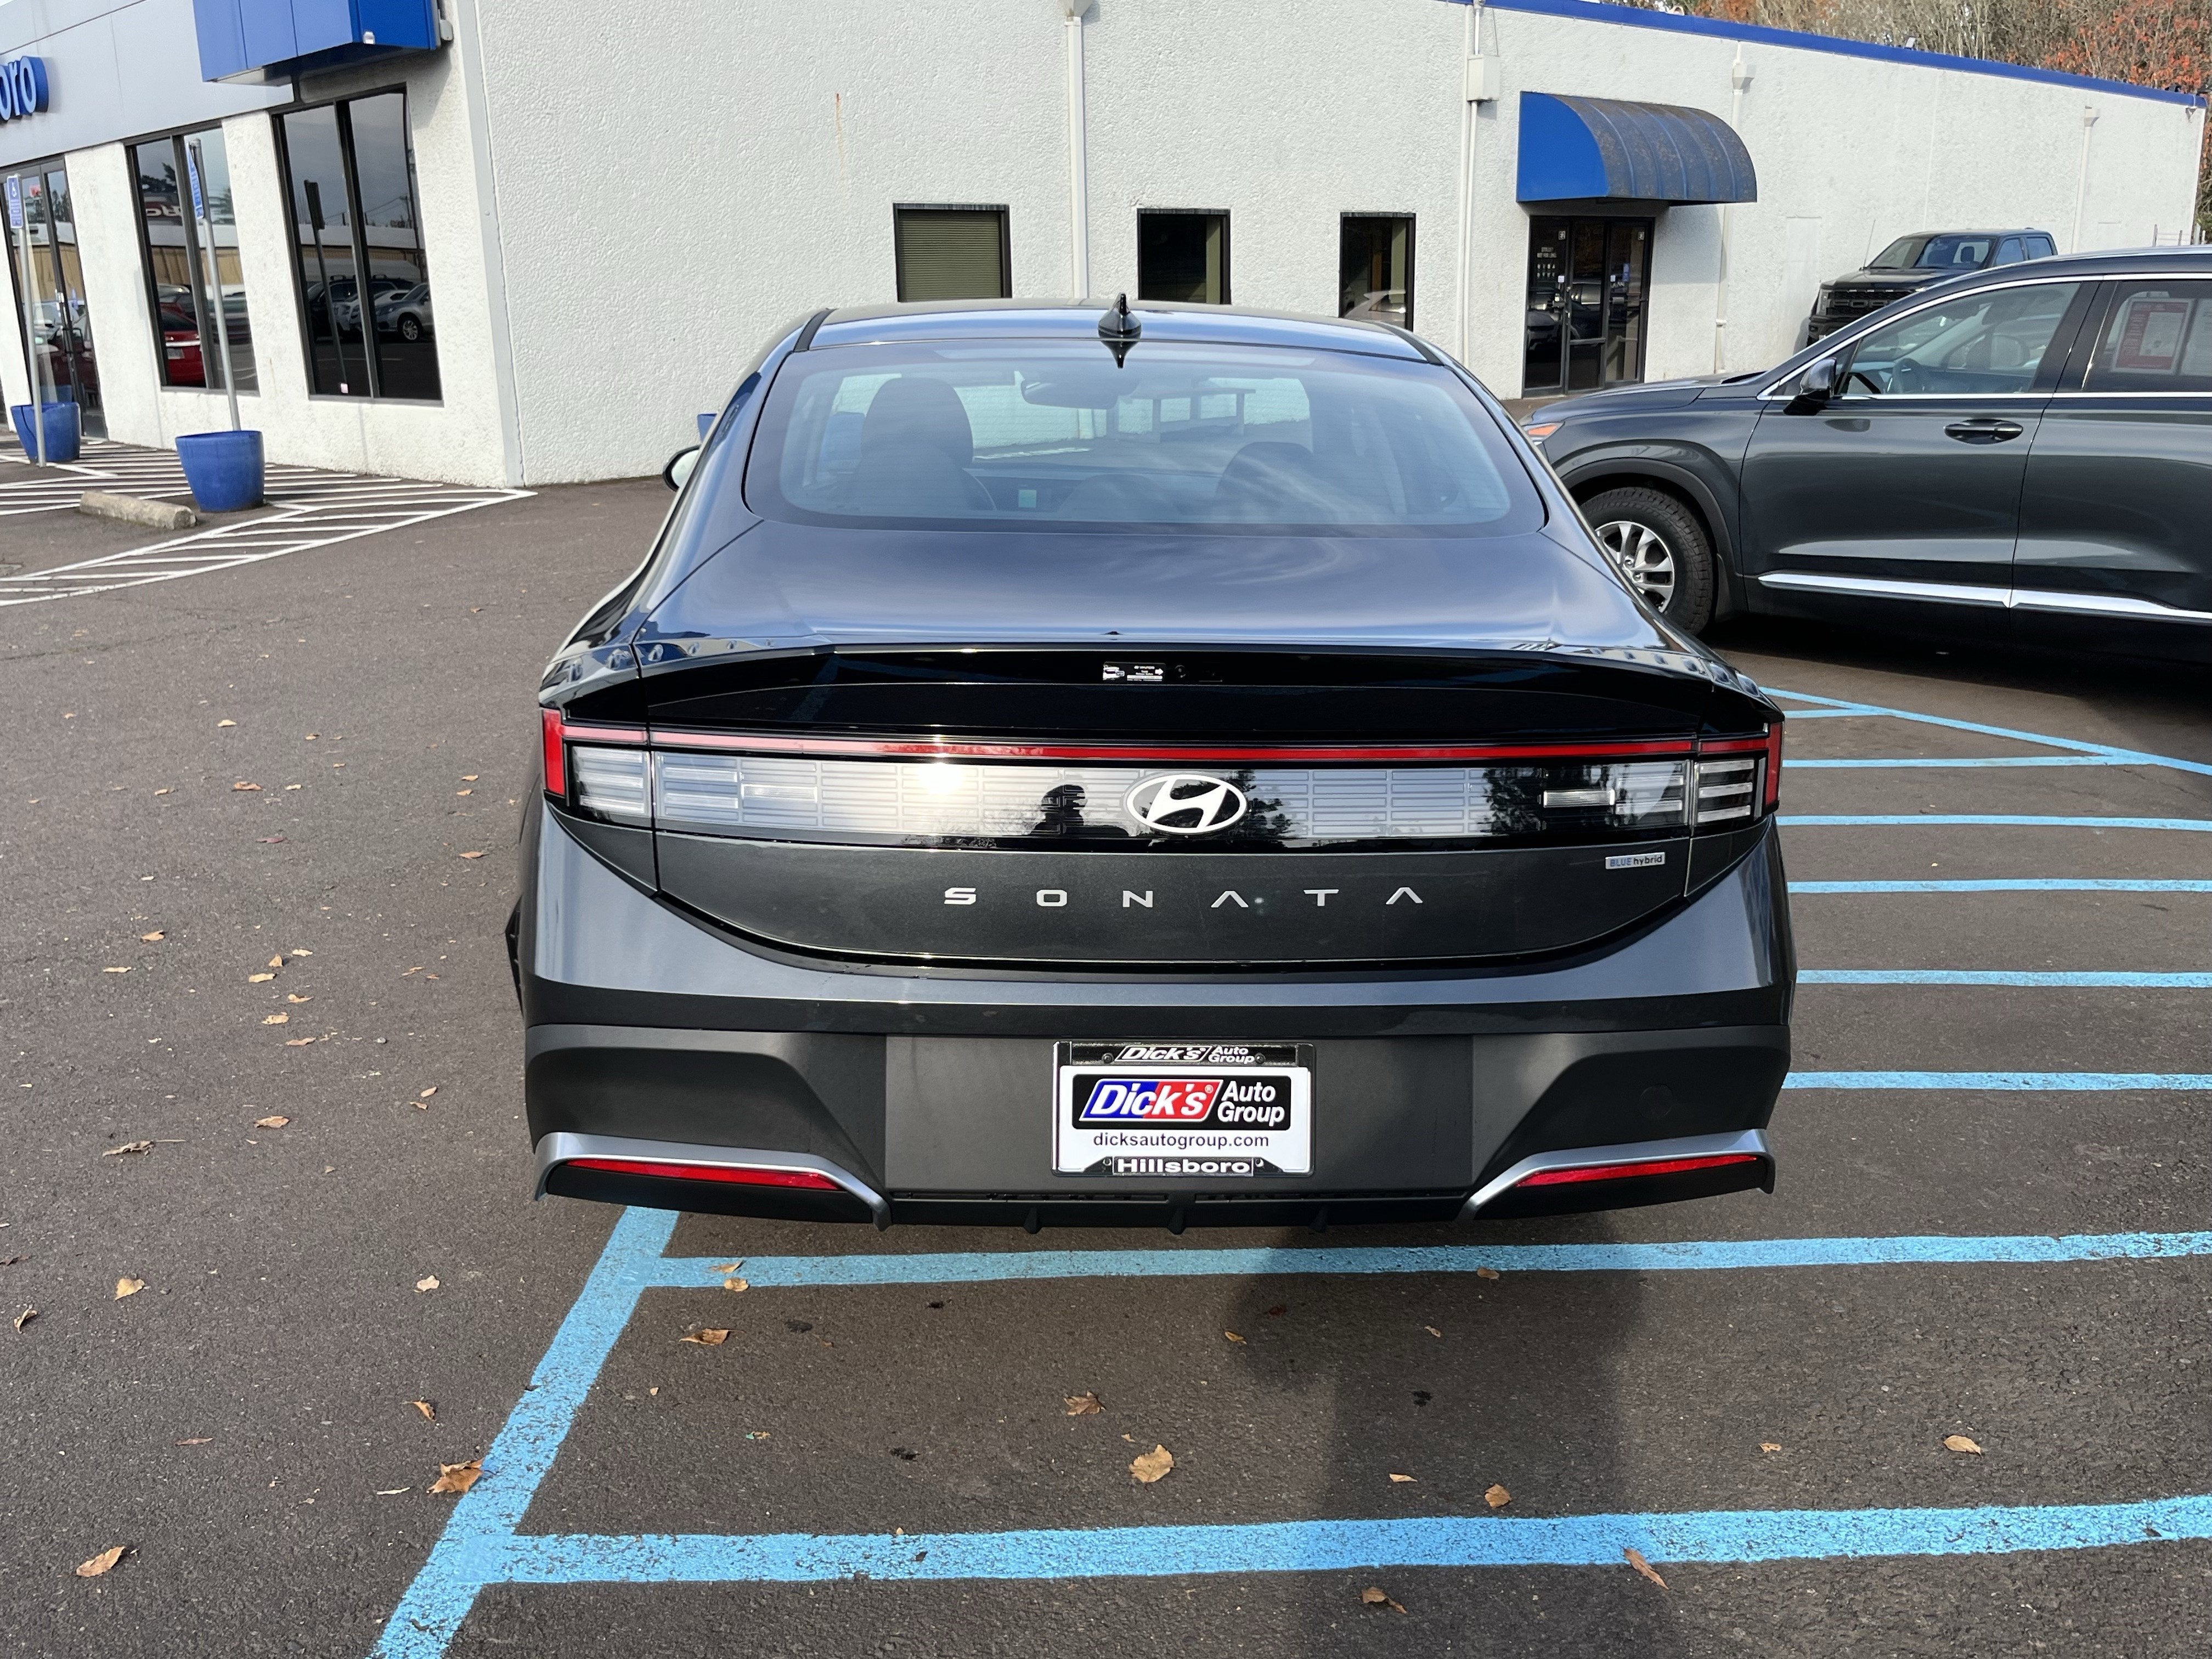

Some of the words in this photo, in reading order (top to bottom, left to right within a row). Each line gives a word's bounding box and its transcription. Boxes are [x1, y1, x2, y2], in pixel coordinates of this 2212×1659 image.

[1830, 298, 1894, 308] FOR
[944, 886, 1424, 908] SONATA
[1211, 1046, 1249, 1055] Auto
[1208, 1054, 1255, 1064] Group
[1221, 1081, 1276, 1103] Auto
[1217, 1102, 1285, 1127] Group
[1093, 1133, 1269, 1150] dicksautogroup.com
[1116, 1158, 1252, 1173] Hillsboro
